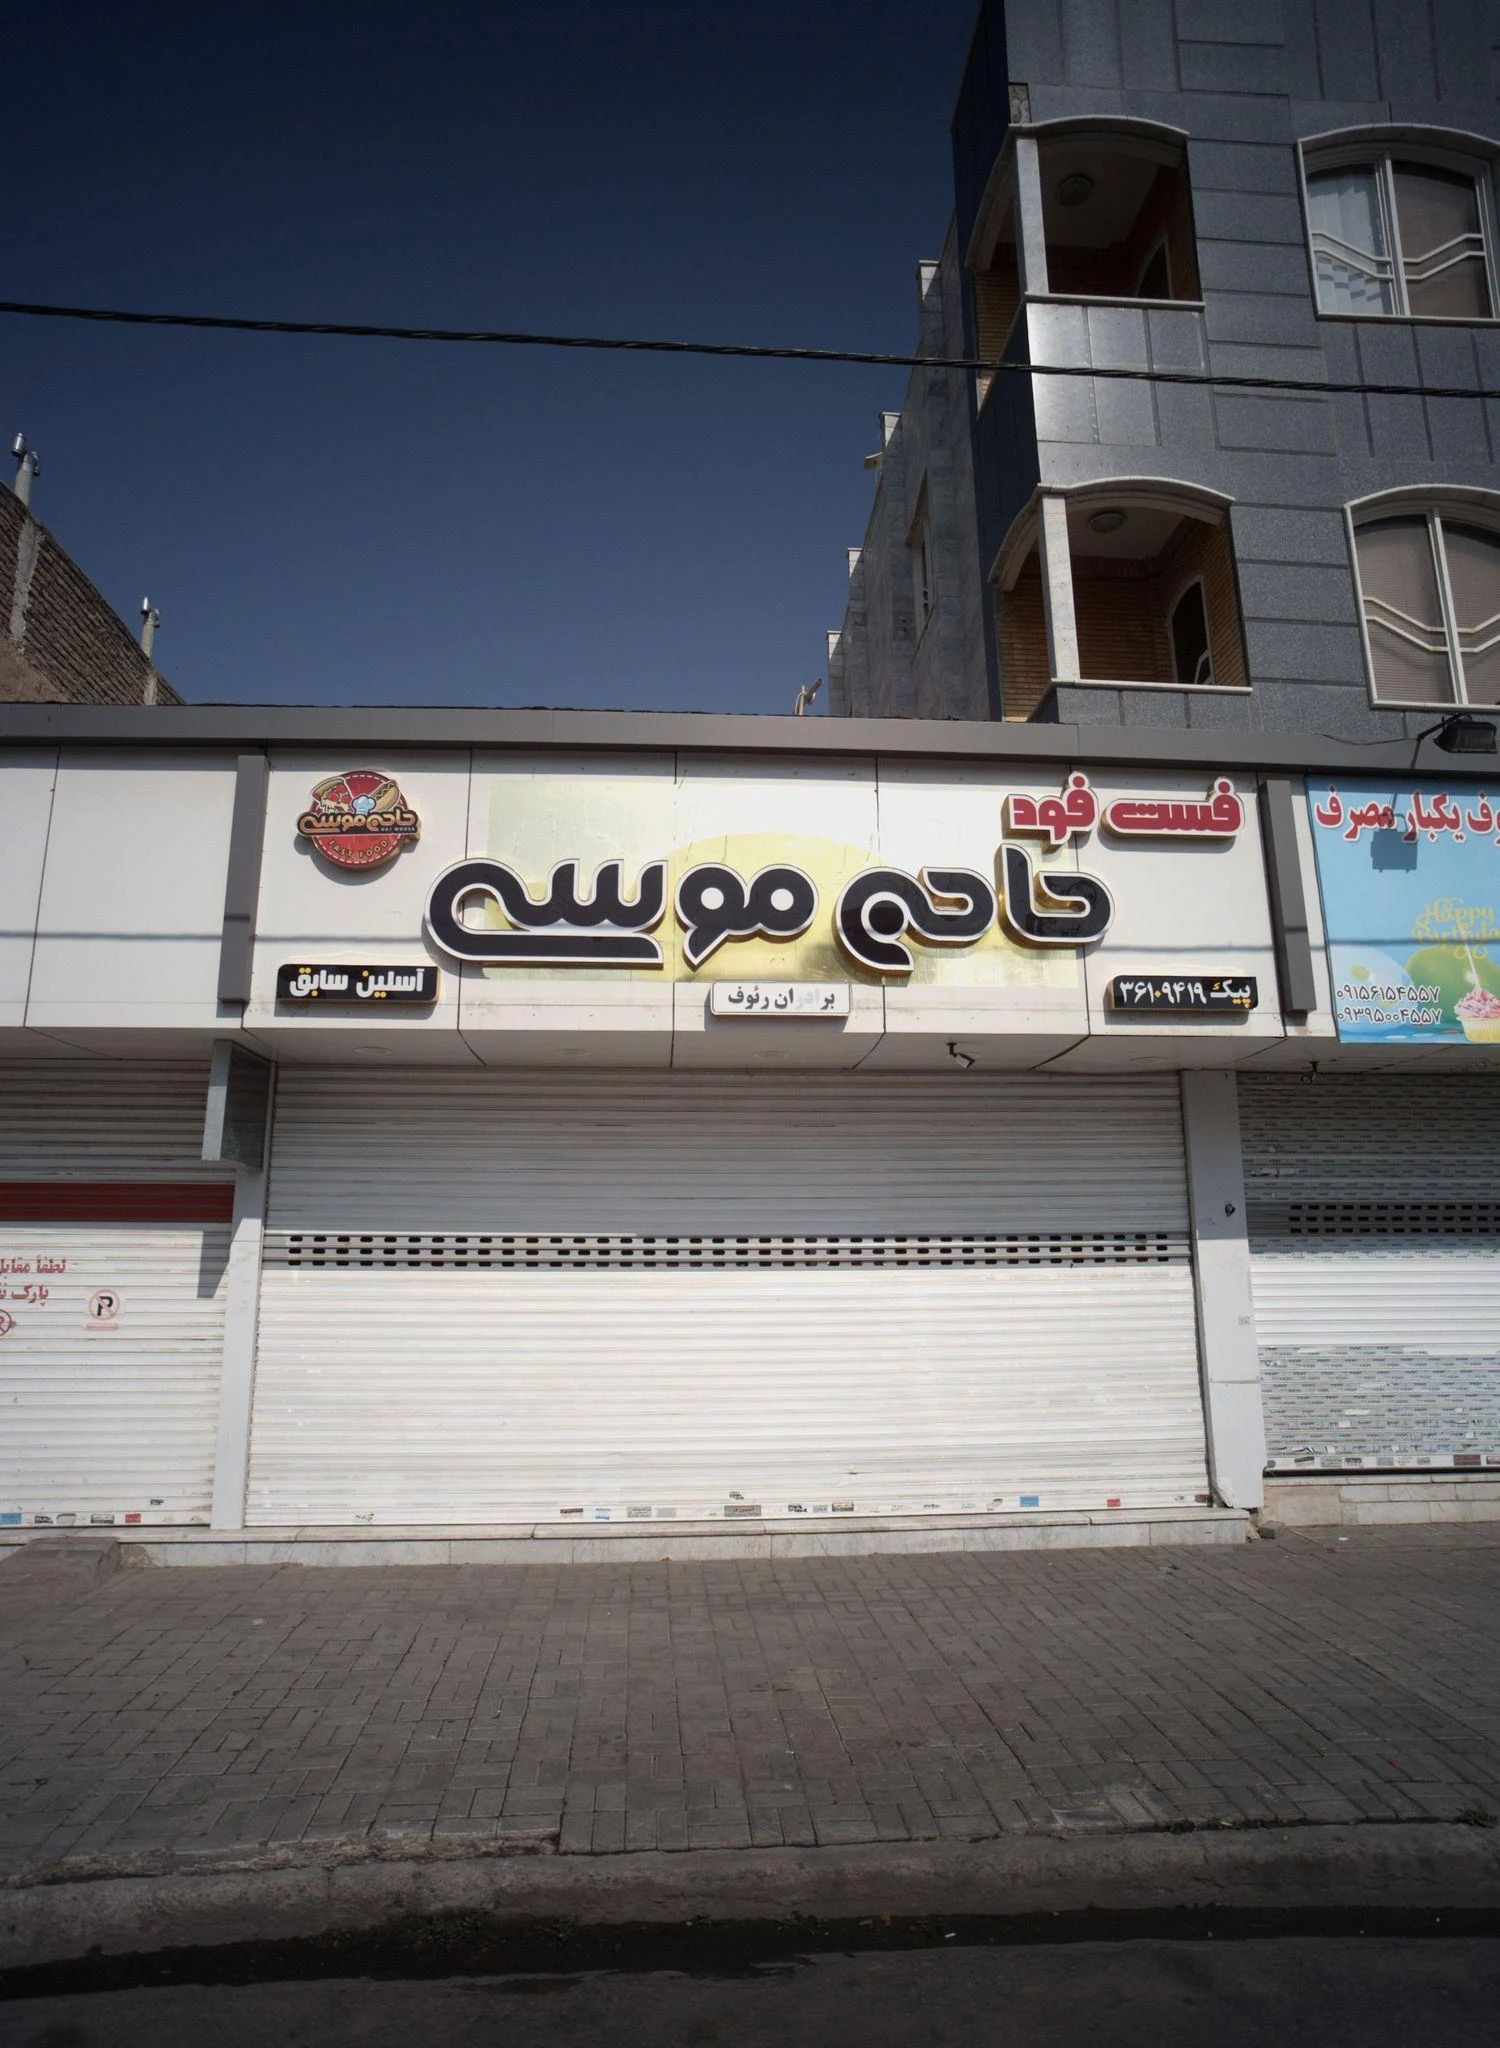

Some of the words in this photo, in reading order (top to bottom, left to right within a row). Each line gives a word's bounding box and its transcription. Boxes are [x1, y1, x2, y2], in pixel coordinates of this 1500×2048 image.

[1007, 770, 1099, 845] فود
[1106, 775, 1244, 835] فست
[1315, 785, 1395, 840] مصرف
[1400, 789, 1465, 842] یکبار
[328, 839, 353, 857] FAST
[359, 840, 388, 858] FOOD
[424, 857, 818, 968] موسی
[1415, 897, 1495, 928] Happy
[1411, 921, 1500, 948] Birthda
[290, 967, 348, 998] سابق
[356, 969, 423, 999] آسلین
[728, 985, 770, 1010] رئوف
[1119, 981, 1207, 1004] ۳۶۱۰۹۴۱۹
[1210, 979, 1251, 1009] پیک
[1337, 984, 1440, 1001] ۰۹۱۵۶۱۵۴۵۵۷
[1338, 1007, 1441, 1023] ۰۹۳۹۵۰۰۴۵۵۷
[11, 1284, 49, 1307] پارک
